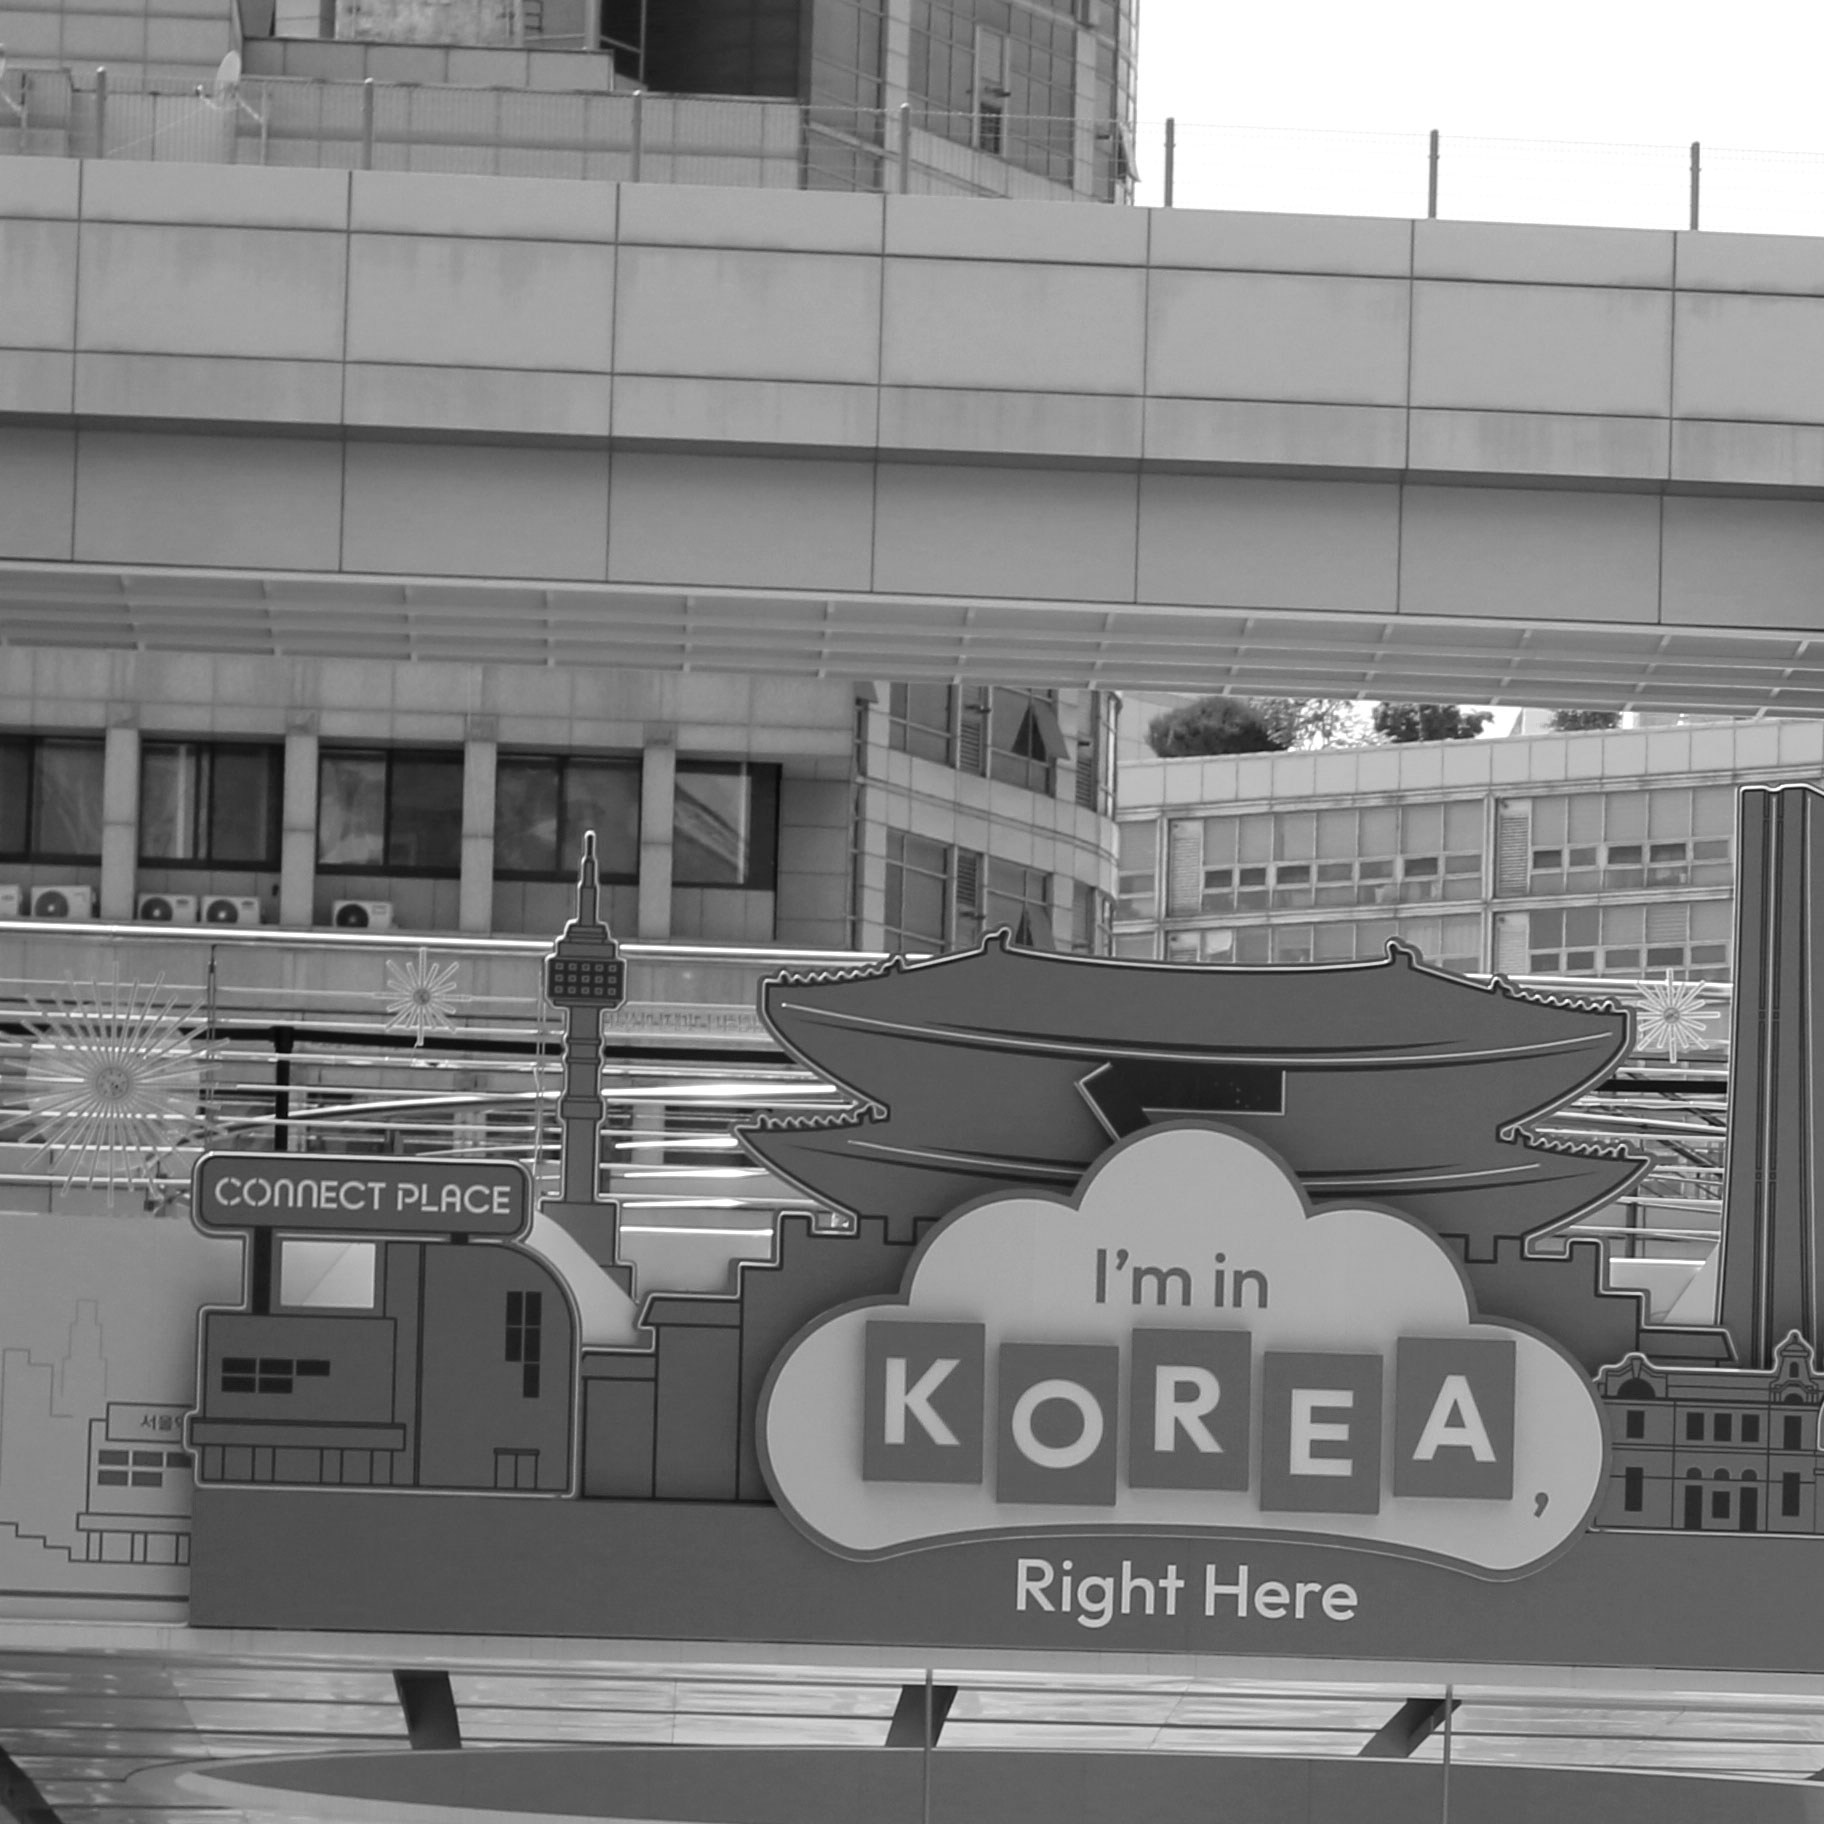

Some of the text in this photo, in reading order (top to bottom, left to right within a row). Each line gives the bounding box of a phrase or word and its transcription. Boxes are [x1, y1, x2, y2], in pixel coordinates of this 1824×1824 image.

[214, 1177, 511, 1215] CONNECT PLACE
[1214, 1253, 1269, 1310] in
[1016, 1557, 1359, 1629] Right Here
